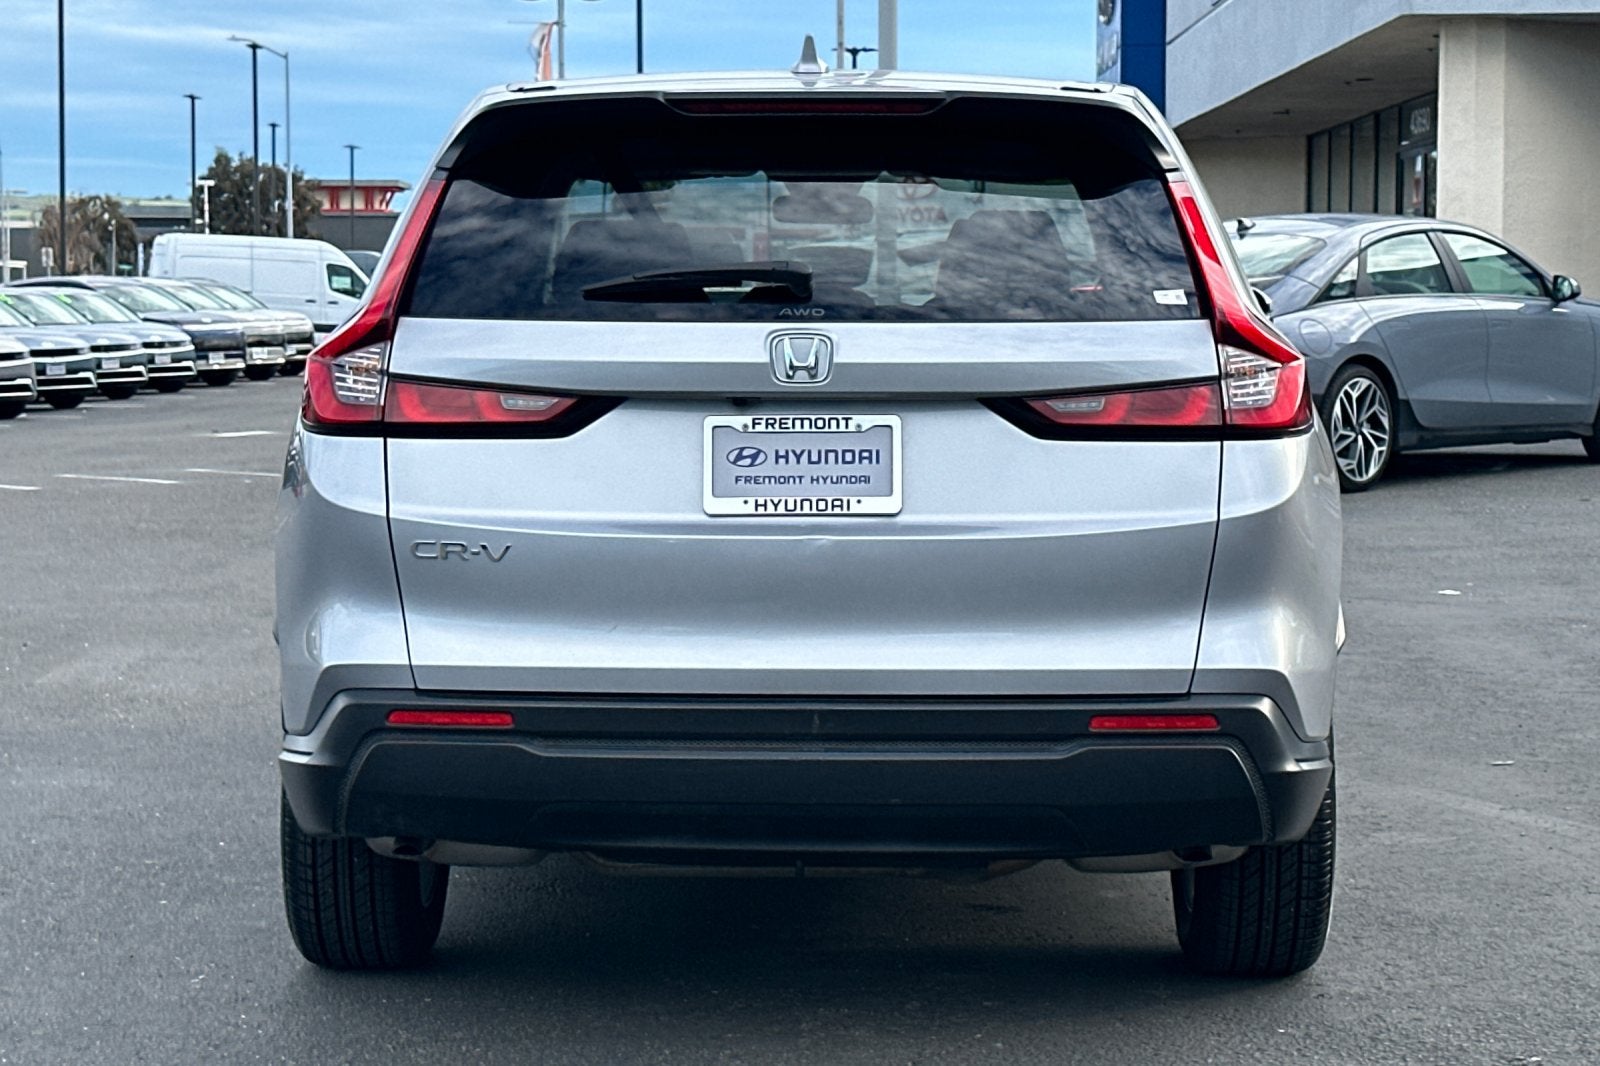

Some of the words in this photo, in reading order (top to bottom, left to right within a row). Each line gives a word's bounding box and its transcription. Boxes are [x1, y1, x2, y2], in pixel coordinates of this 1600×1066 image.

[896, 206, 949, 223] YOTA
[779, 308, 825, 317] AWD
[751, 416, 853, 430] FREMONT
[774, 449, 881, 465] HYUNDAI
[734, 475, 805, 485] FREMONT
[810, 475, 871, 485] HYUNDAI
[754, 498, 851, 513] HYUNDAI
[410, 540, 513, 562] CR-V
